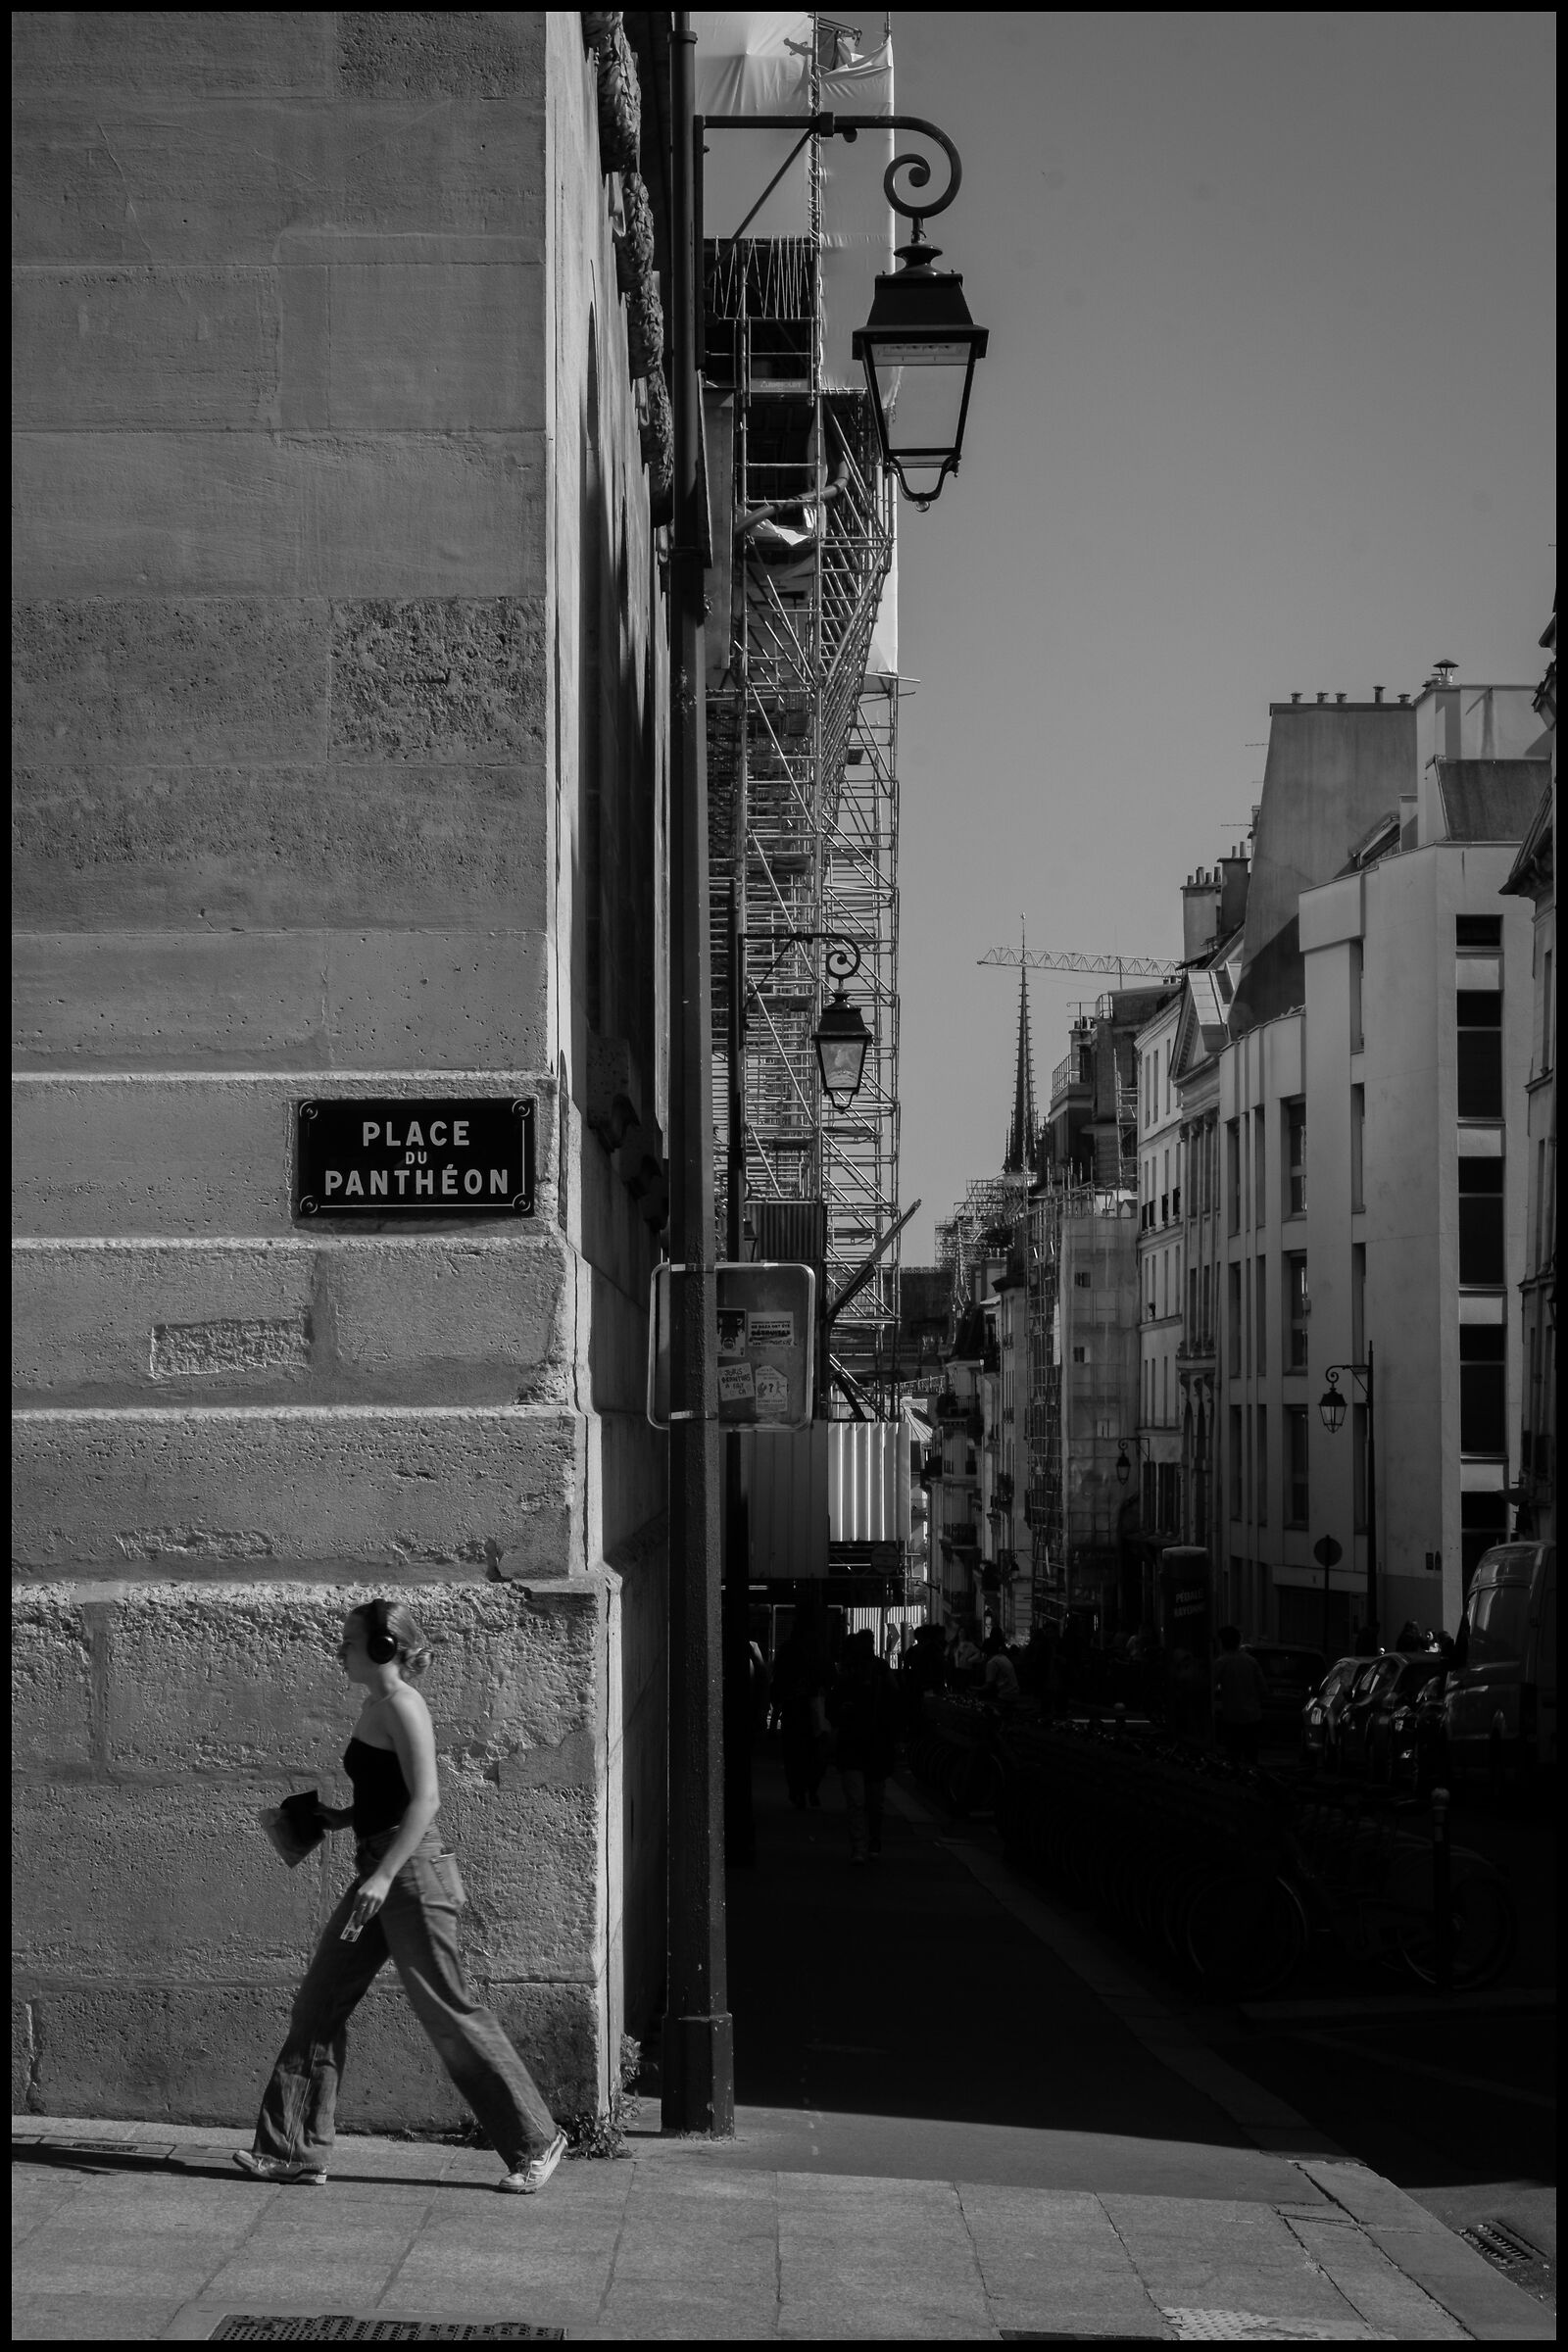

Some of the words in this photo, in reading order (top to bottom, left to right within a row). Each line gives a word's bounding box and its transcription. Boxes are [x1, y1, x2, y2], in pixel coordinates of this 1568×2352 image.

[362, 1120, 470, 1147] PLACE
[405, 1151, 428, 1165] DU
[324, 1163, 509, 1197] PANTHÉON
